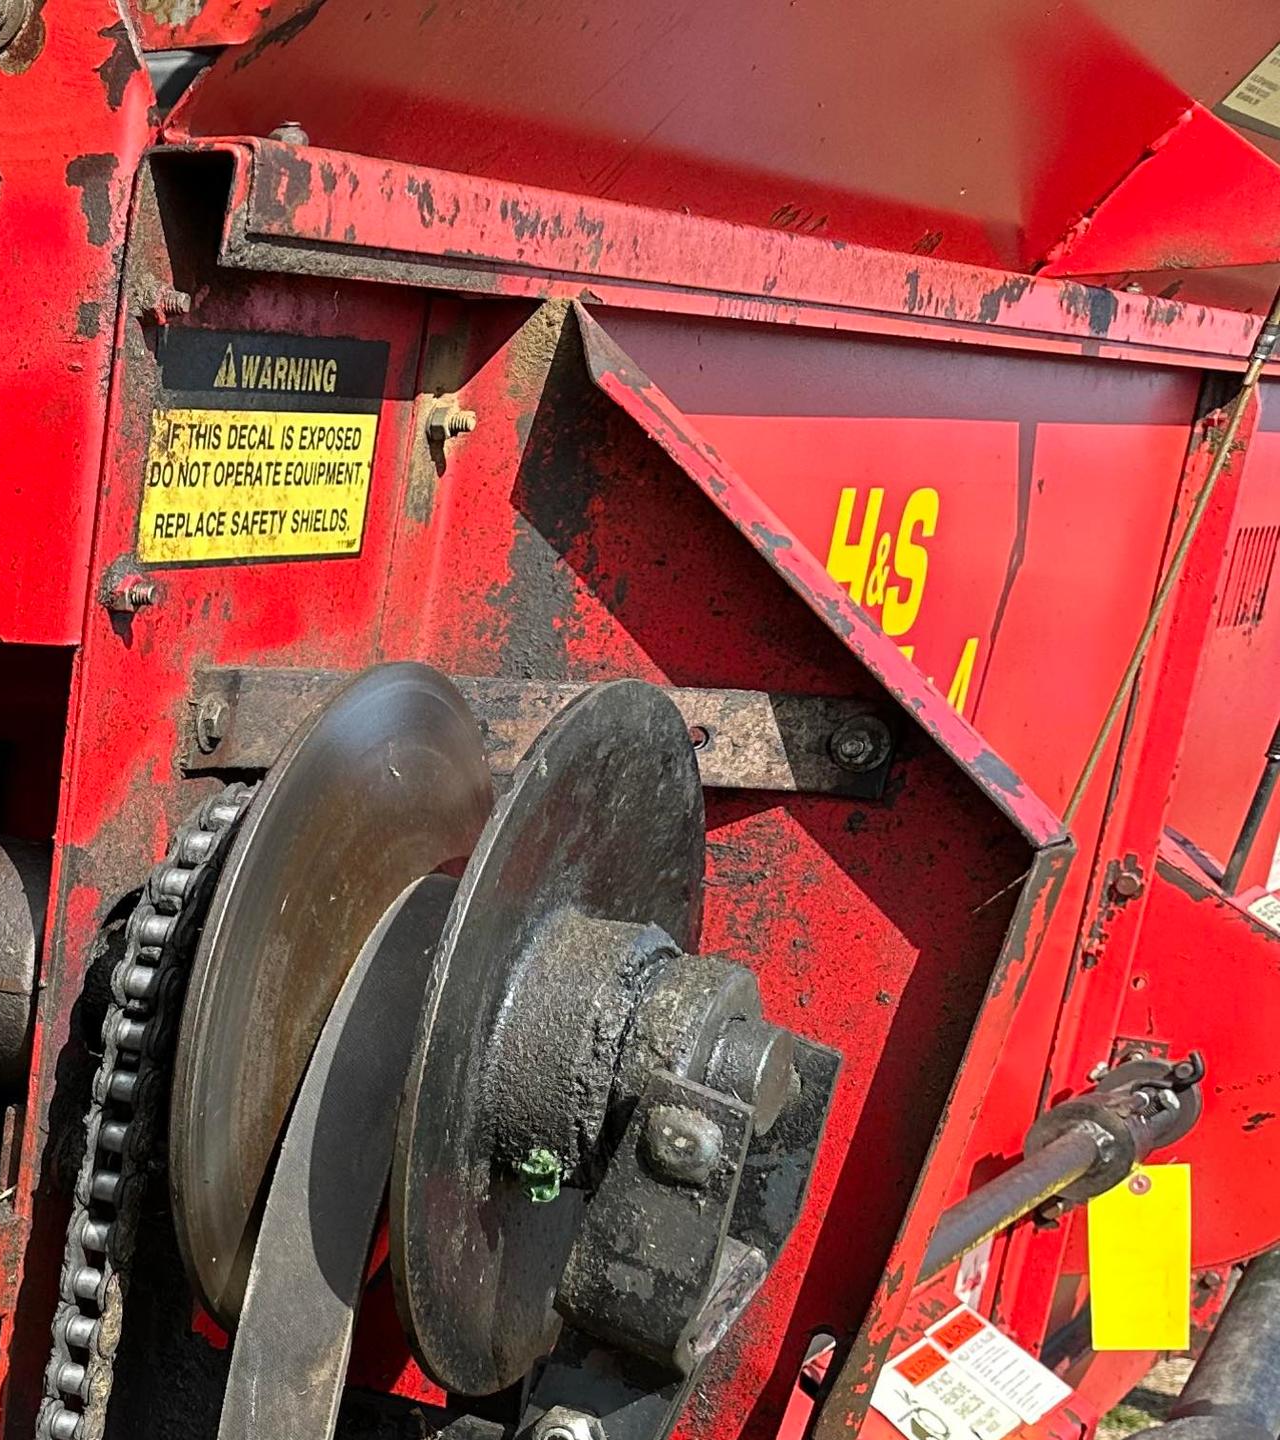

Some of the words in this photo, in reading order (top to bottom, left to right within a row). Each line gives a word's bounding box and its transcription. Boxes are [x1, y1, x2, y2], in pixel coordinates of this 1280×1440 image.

[241, 355, 338, 393] WARNING
[189, 423, 222, 450] THIS
[226, 424, 275, 450] DECAL
[281, 426, 294, 450] IS
[298, 426, 362, 451] EXPOSED
[150, 461, 174, 488] DO
[177, 461, 211, 487] NOT
[214, 462, 282, 487] OPERATE
[153, 512, 226, 538] REPLACE
[230, 510, 286, 535] SAFETY
[290, 508, 350, 534] SHIELDS.
[826, 488, 939, 636] H&S
